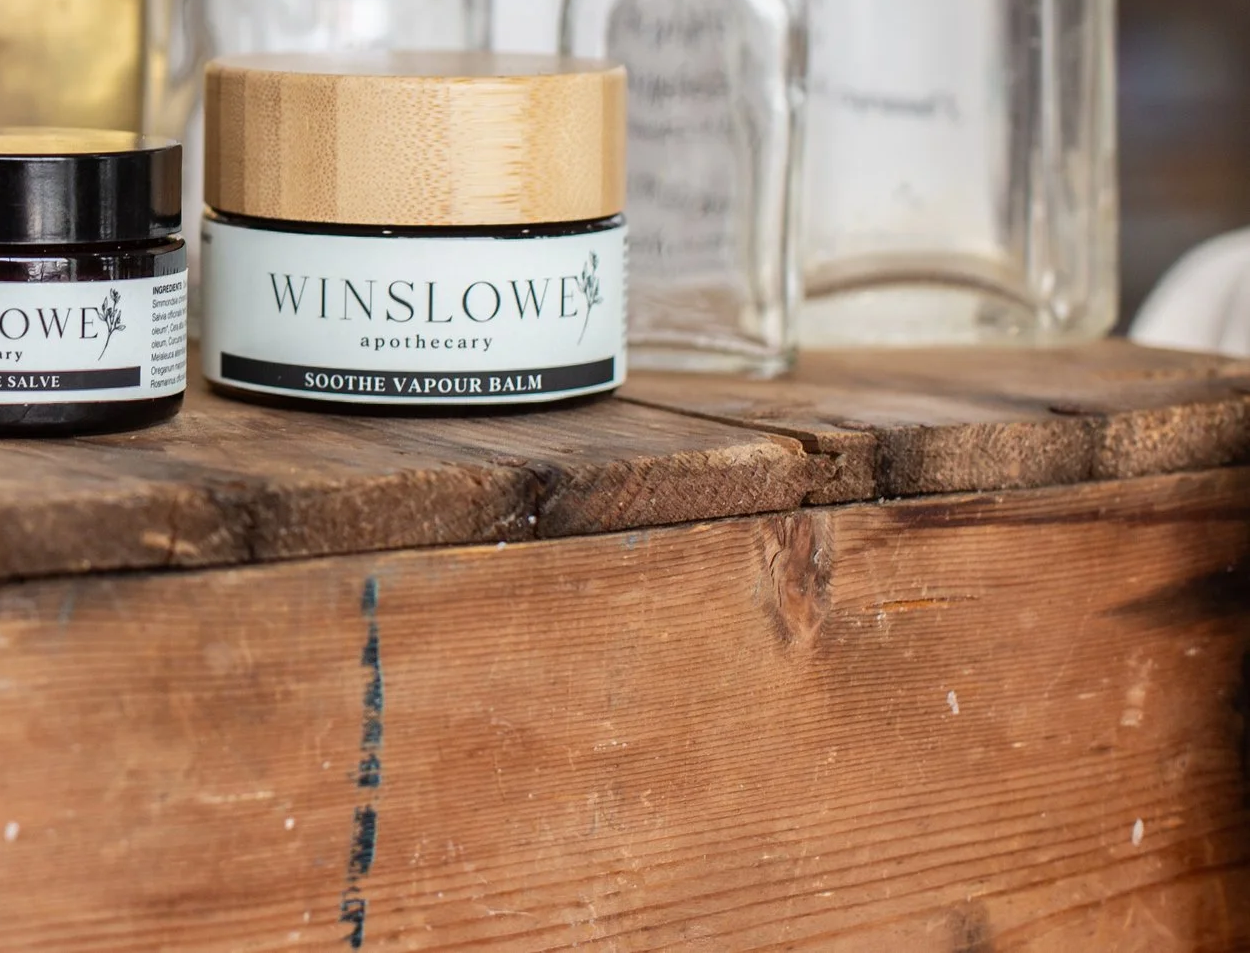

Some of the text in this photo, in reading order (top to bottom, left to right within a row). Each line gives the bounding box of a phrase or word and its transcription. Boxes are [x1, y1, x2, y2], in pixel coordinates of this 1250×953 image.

[267, 272, 580, 324] WINSLOWE
[360, 334, 494, 352] apothecary
[7, 375, 61, 389] SALVE
[304, 371, 543, 393] SOOTHE VAPOUR BALM
